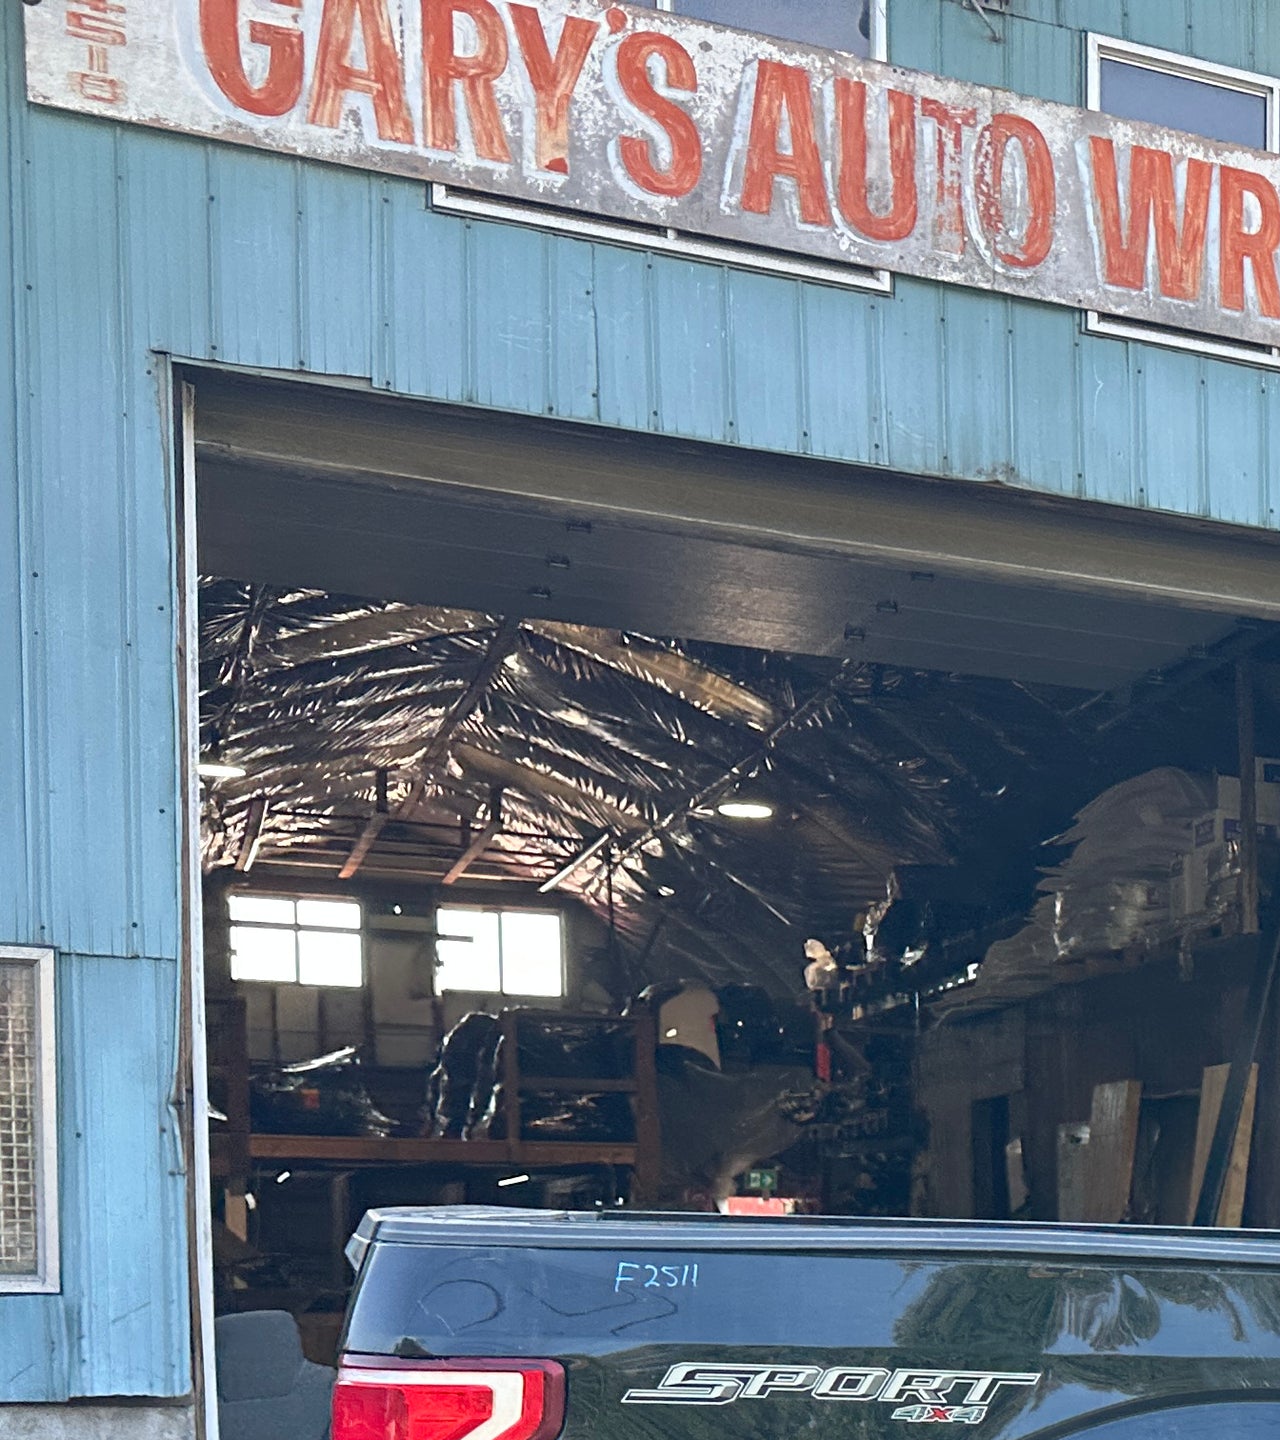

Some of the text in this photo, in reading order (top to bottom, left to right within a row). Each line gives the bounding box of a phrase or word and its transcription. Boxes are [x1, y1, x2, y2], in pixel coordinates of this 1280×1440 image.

[200, 0, 702, 198] GARY'S
[741, 58, 1056, 270] AUTO
[613, 1261, 699, 1293] F2511
[620, 1361, 1042, 1406] SPORT
